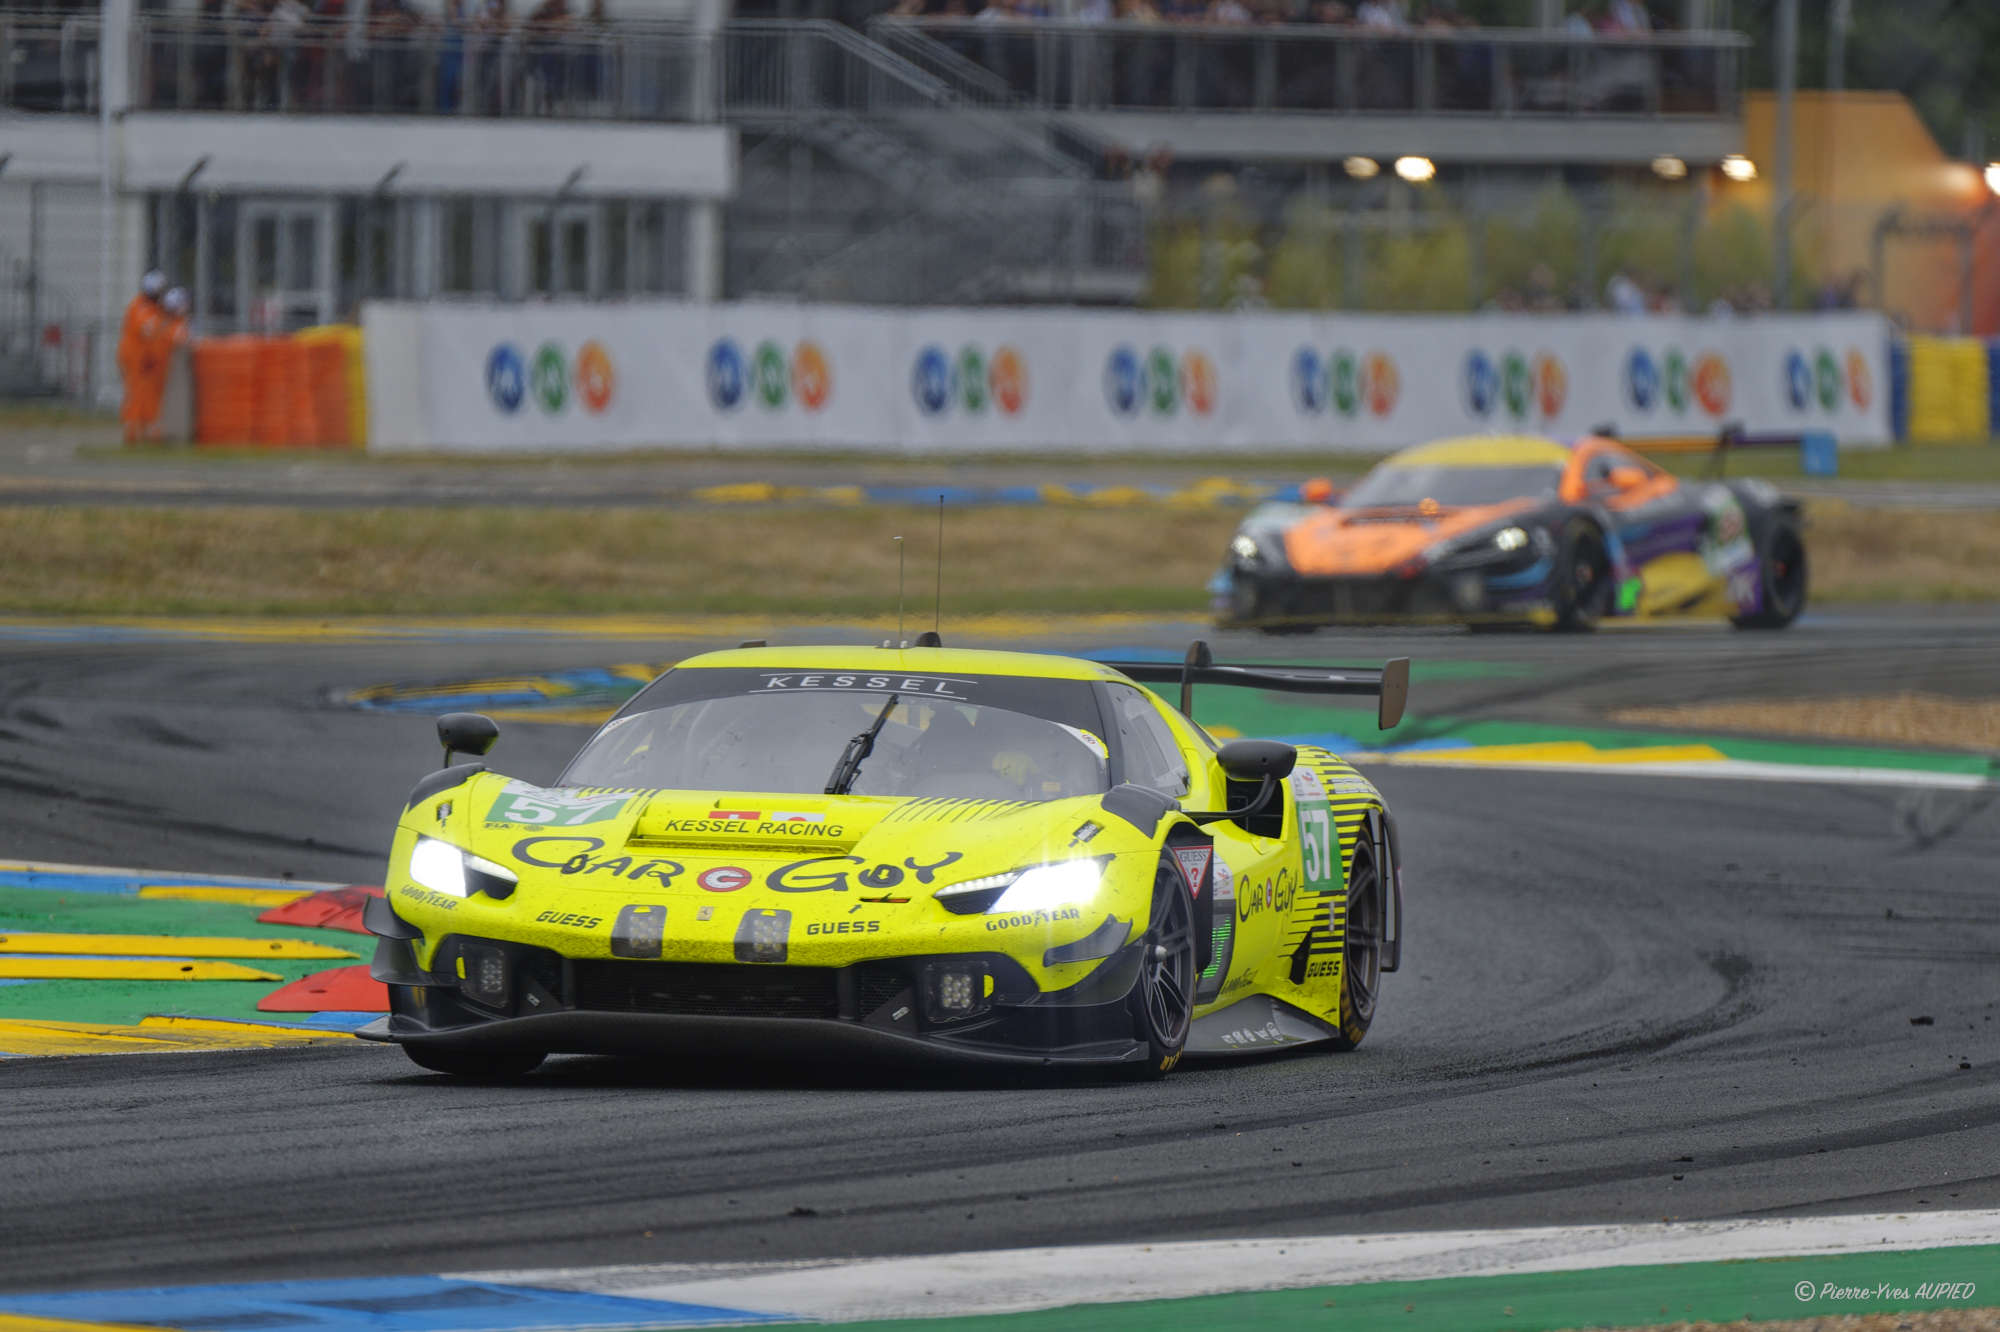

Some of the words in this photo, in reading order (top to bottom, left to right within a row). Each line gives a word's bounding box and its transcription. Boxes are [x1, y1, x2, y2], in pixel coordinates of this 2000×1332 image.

[767, 676, 955, 694] KESSEL
[504, 797, 617, 825] 57
[665, 818, 750, 833] KESSEL
[757, 821, 844, 837] RACING
[1301, 809, 1331, 882] 57
[511, 836, 685, 889] CAR
[535, 911, 603, 929] GUESS
[807, 920, 881, 936] GUESS
[985, 908, 1080, 932] GOODYEAR
[1307, 961, 1340, 978] GUESS
